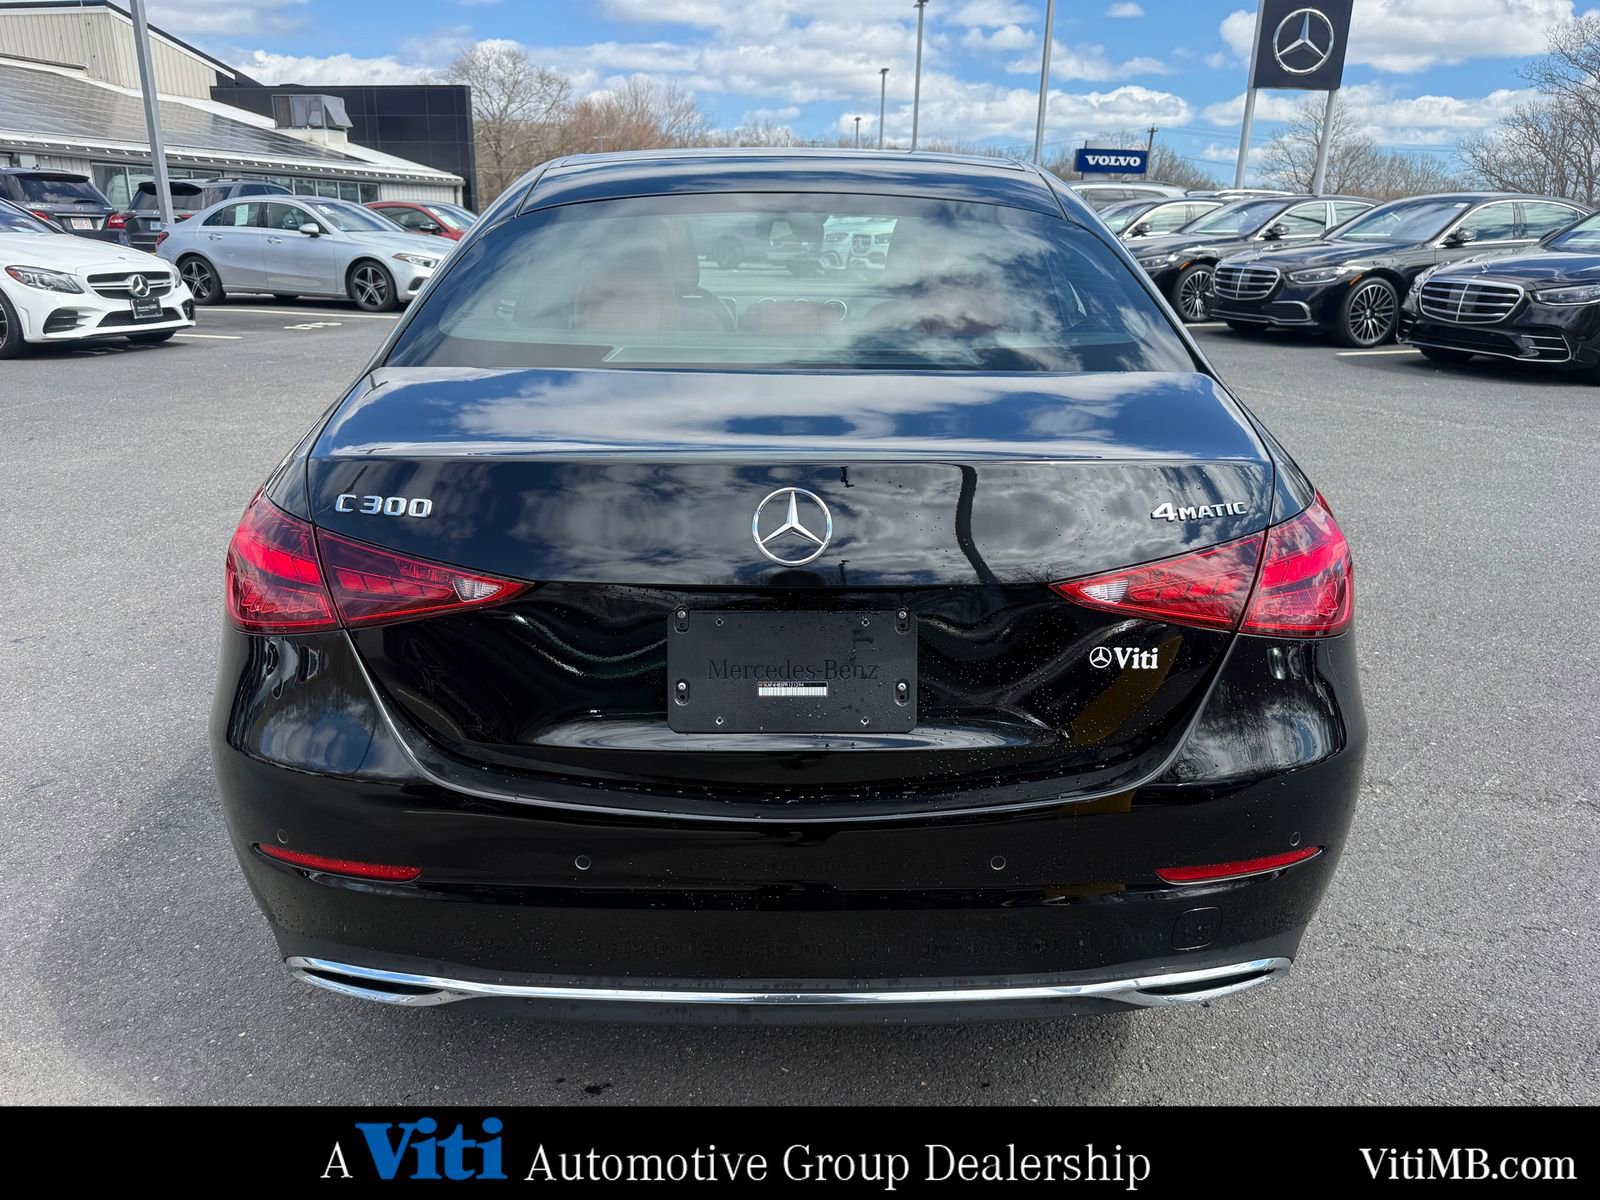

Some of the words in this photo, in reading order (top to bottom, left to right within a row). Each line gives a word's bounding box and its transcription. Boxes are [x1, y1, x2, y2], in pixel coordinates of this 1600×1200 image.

[1085, 155, 1141, 167] VOLVO
[335, 494, 357, 513] C
[360, 495, 433, 518] 300
[1151, 502, 1247, 521] 4MATIC
[1113, 647, 1159, 670] Viti
[707, 659, 879, 681] Mercedes-Benz
